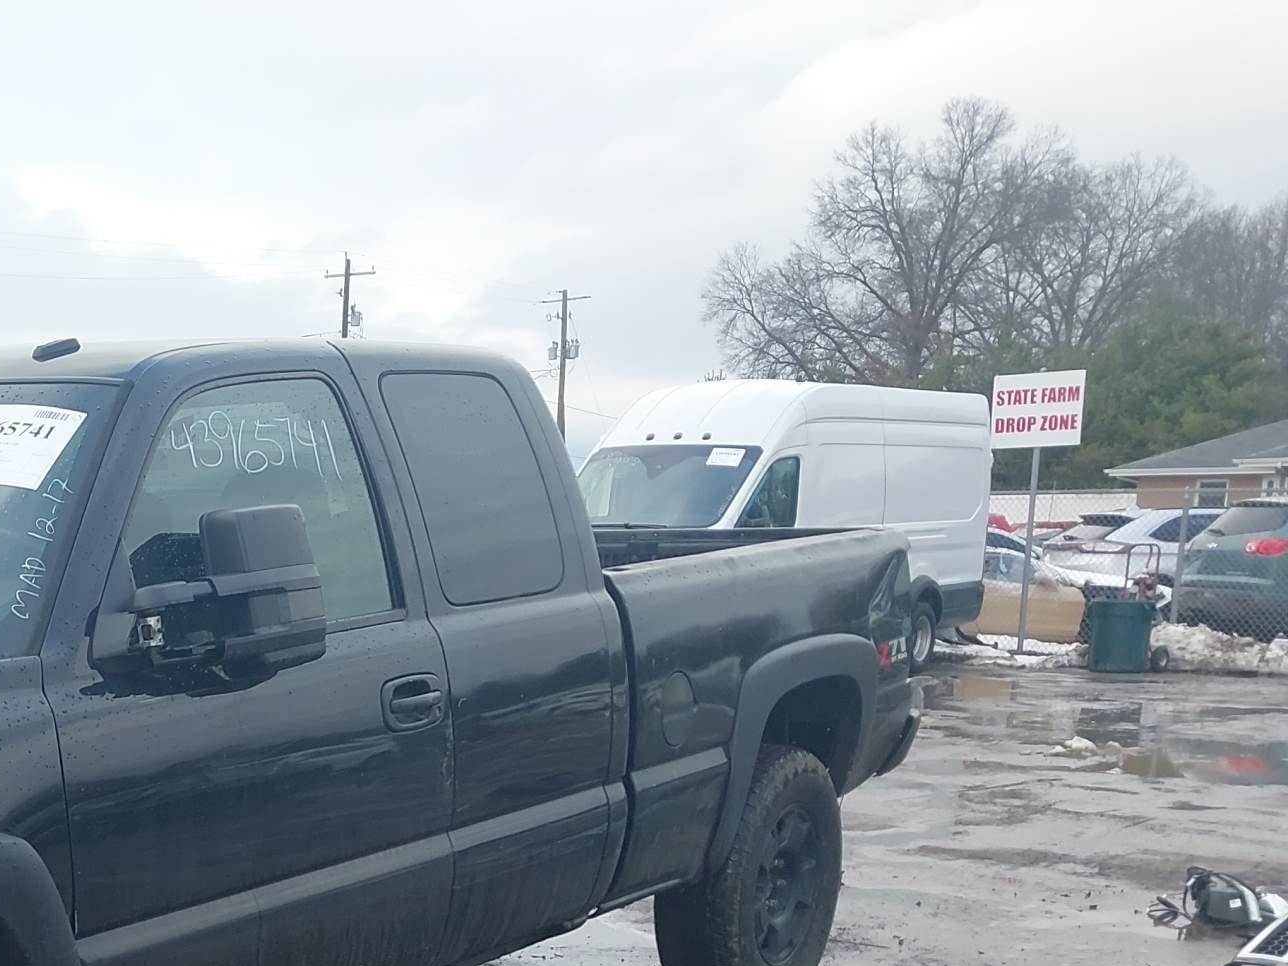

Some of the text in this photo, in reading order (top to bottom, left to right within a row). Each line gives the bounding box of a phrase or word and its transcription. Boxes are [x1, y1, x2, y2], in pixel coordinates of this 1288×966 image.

[996, 385, 1081, 407] STATE FARM
[994, 413, 1078, 434] DROP ZONE
[170, 410, 343, 481] 43965741
[27, 478, 73, 542] 12-17
